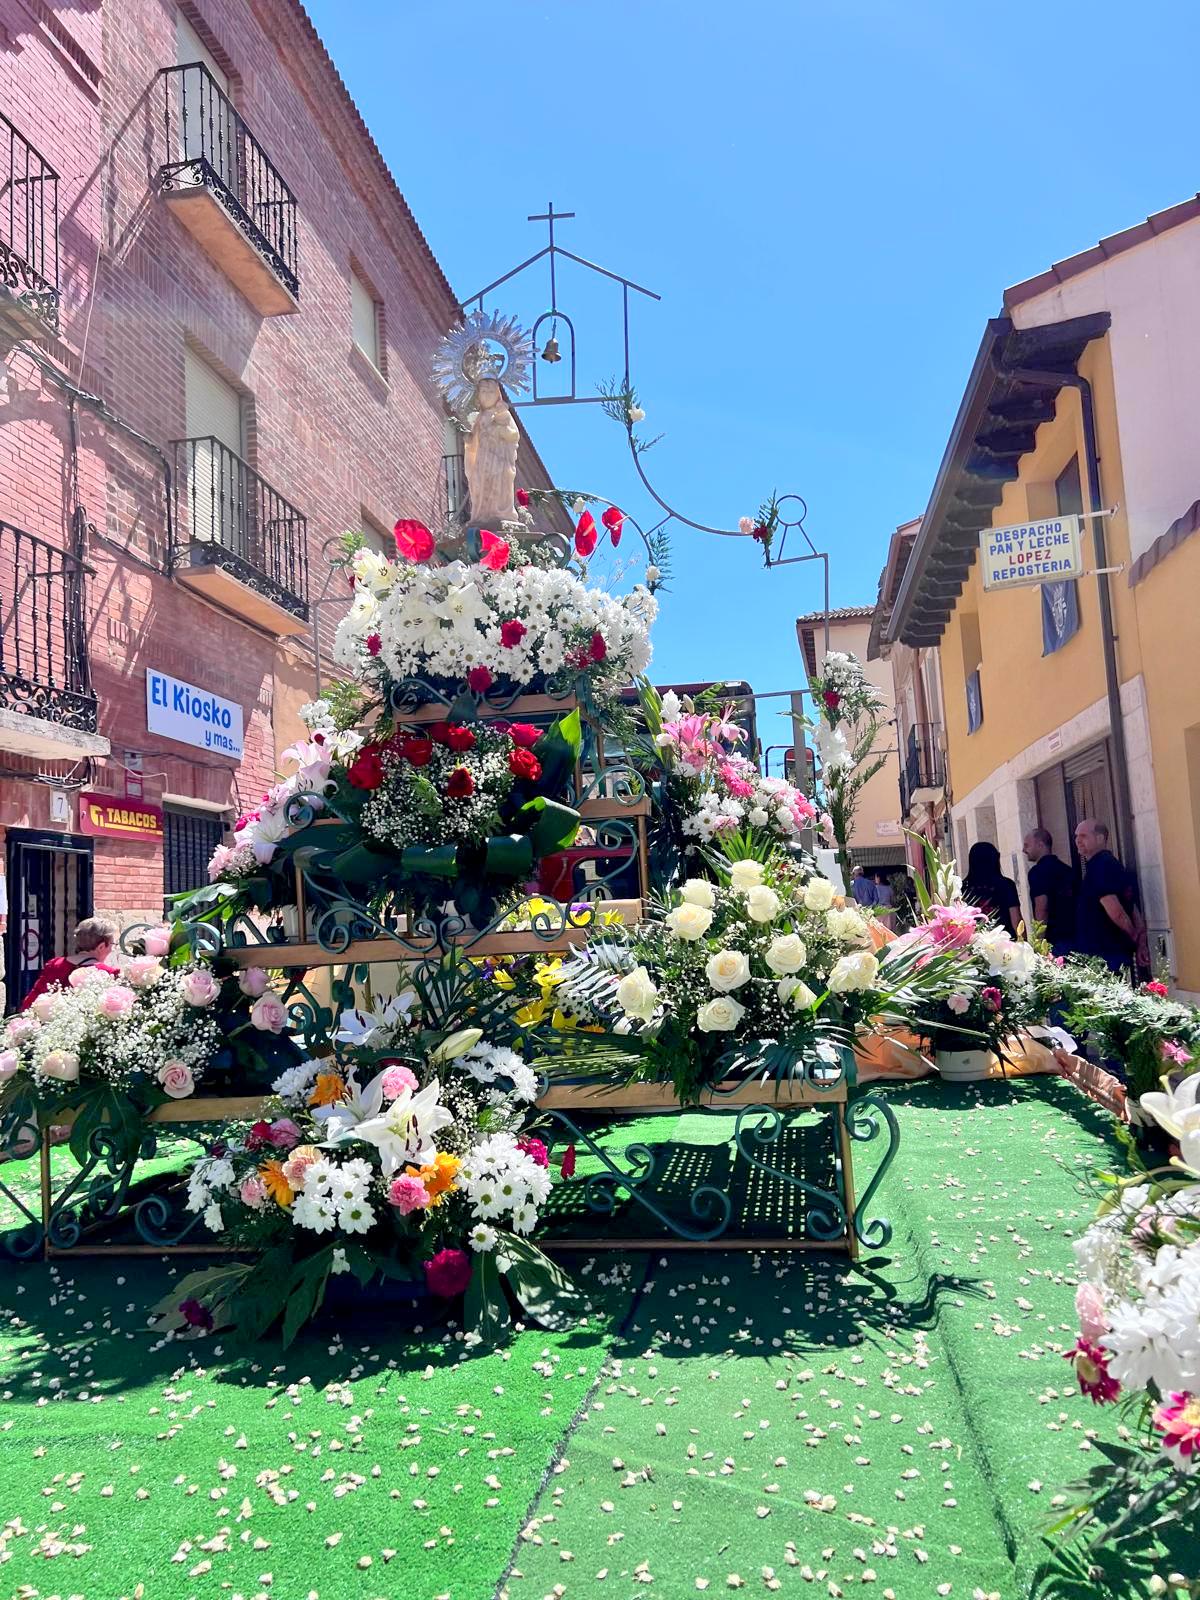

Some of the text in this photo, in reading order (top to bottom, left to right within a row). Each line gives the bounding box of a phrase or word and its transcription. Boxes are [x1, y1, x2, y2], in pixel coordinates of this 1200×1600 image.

[995, 522, 1062, 543] DESPACHO
[990, 533, 1070, 556] PAN Y LECHE
[1009, 549, 1052, 565] LOPEZ
[993, 559, 1072, 581] REPOSTERIA
[152, 676, 231, 729] El Kiosko
[205, 730, 212, 747] y
[58, 797, 63, 814] 7
[106, 807, 157, 829] TABACOS
